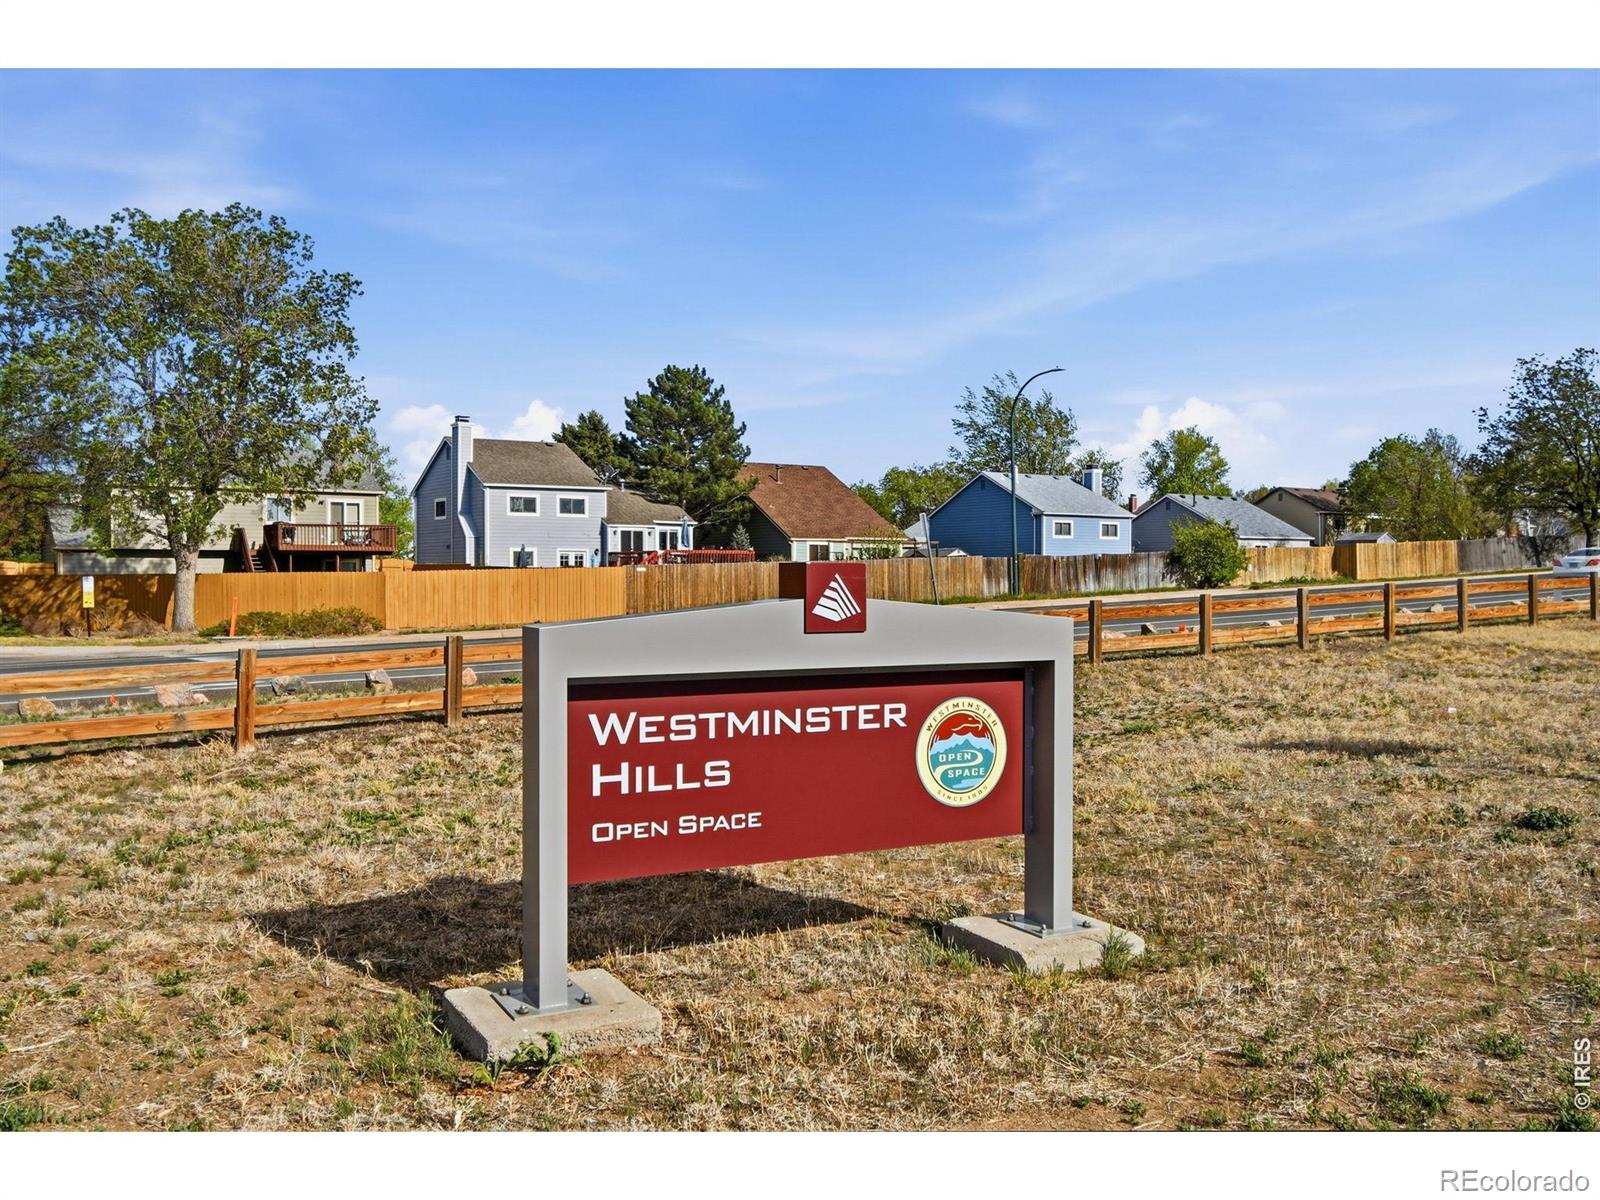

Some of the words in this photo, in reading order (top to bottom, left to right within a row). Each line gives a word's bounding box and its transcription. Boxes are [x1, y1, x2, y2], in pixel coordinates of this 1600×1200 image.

[926, 701, 997, 732] WESTMINSTER
[939, 752, 972, 763] OPEN
[947, 767, 985, 778] SPACE
